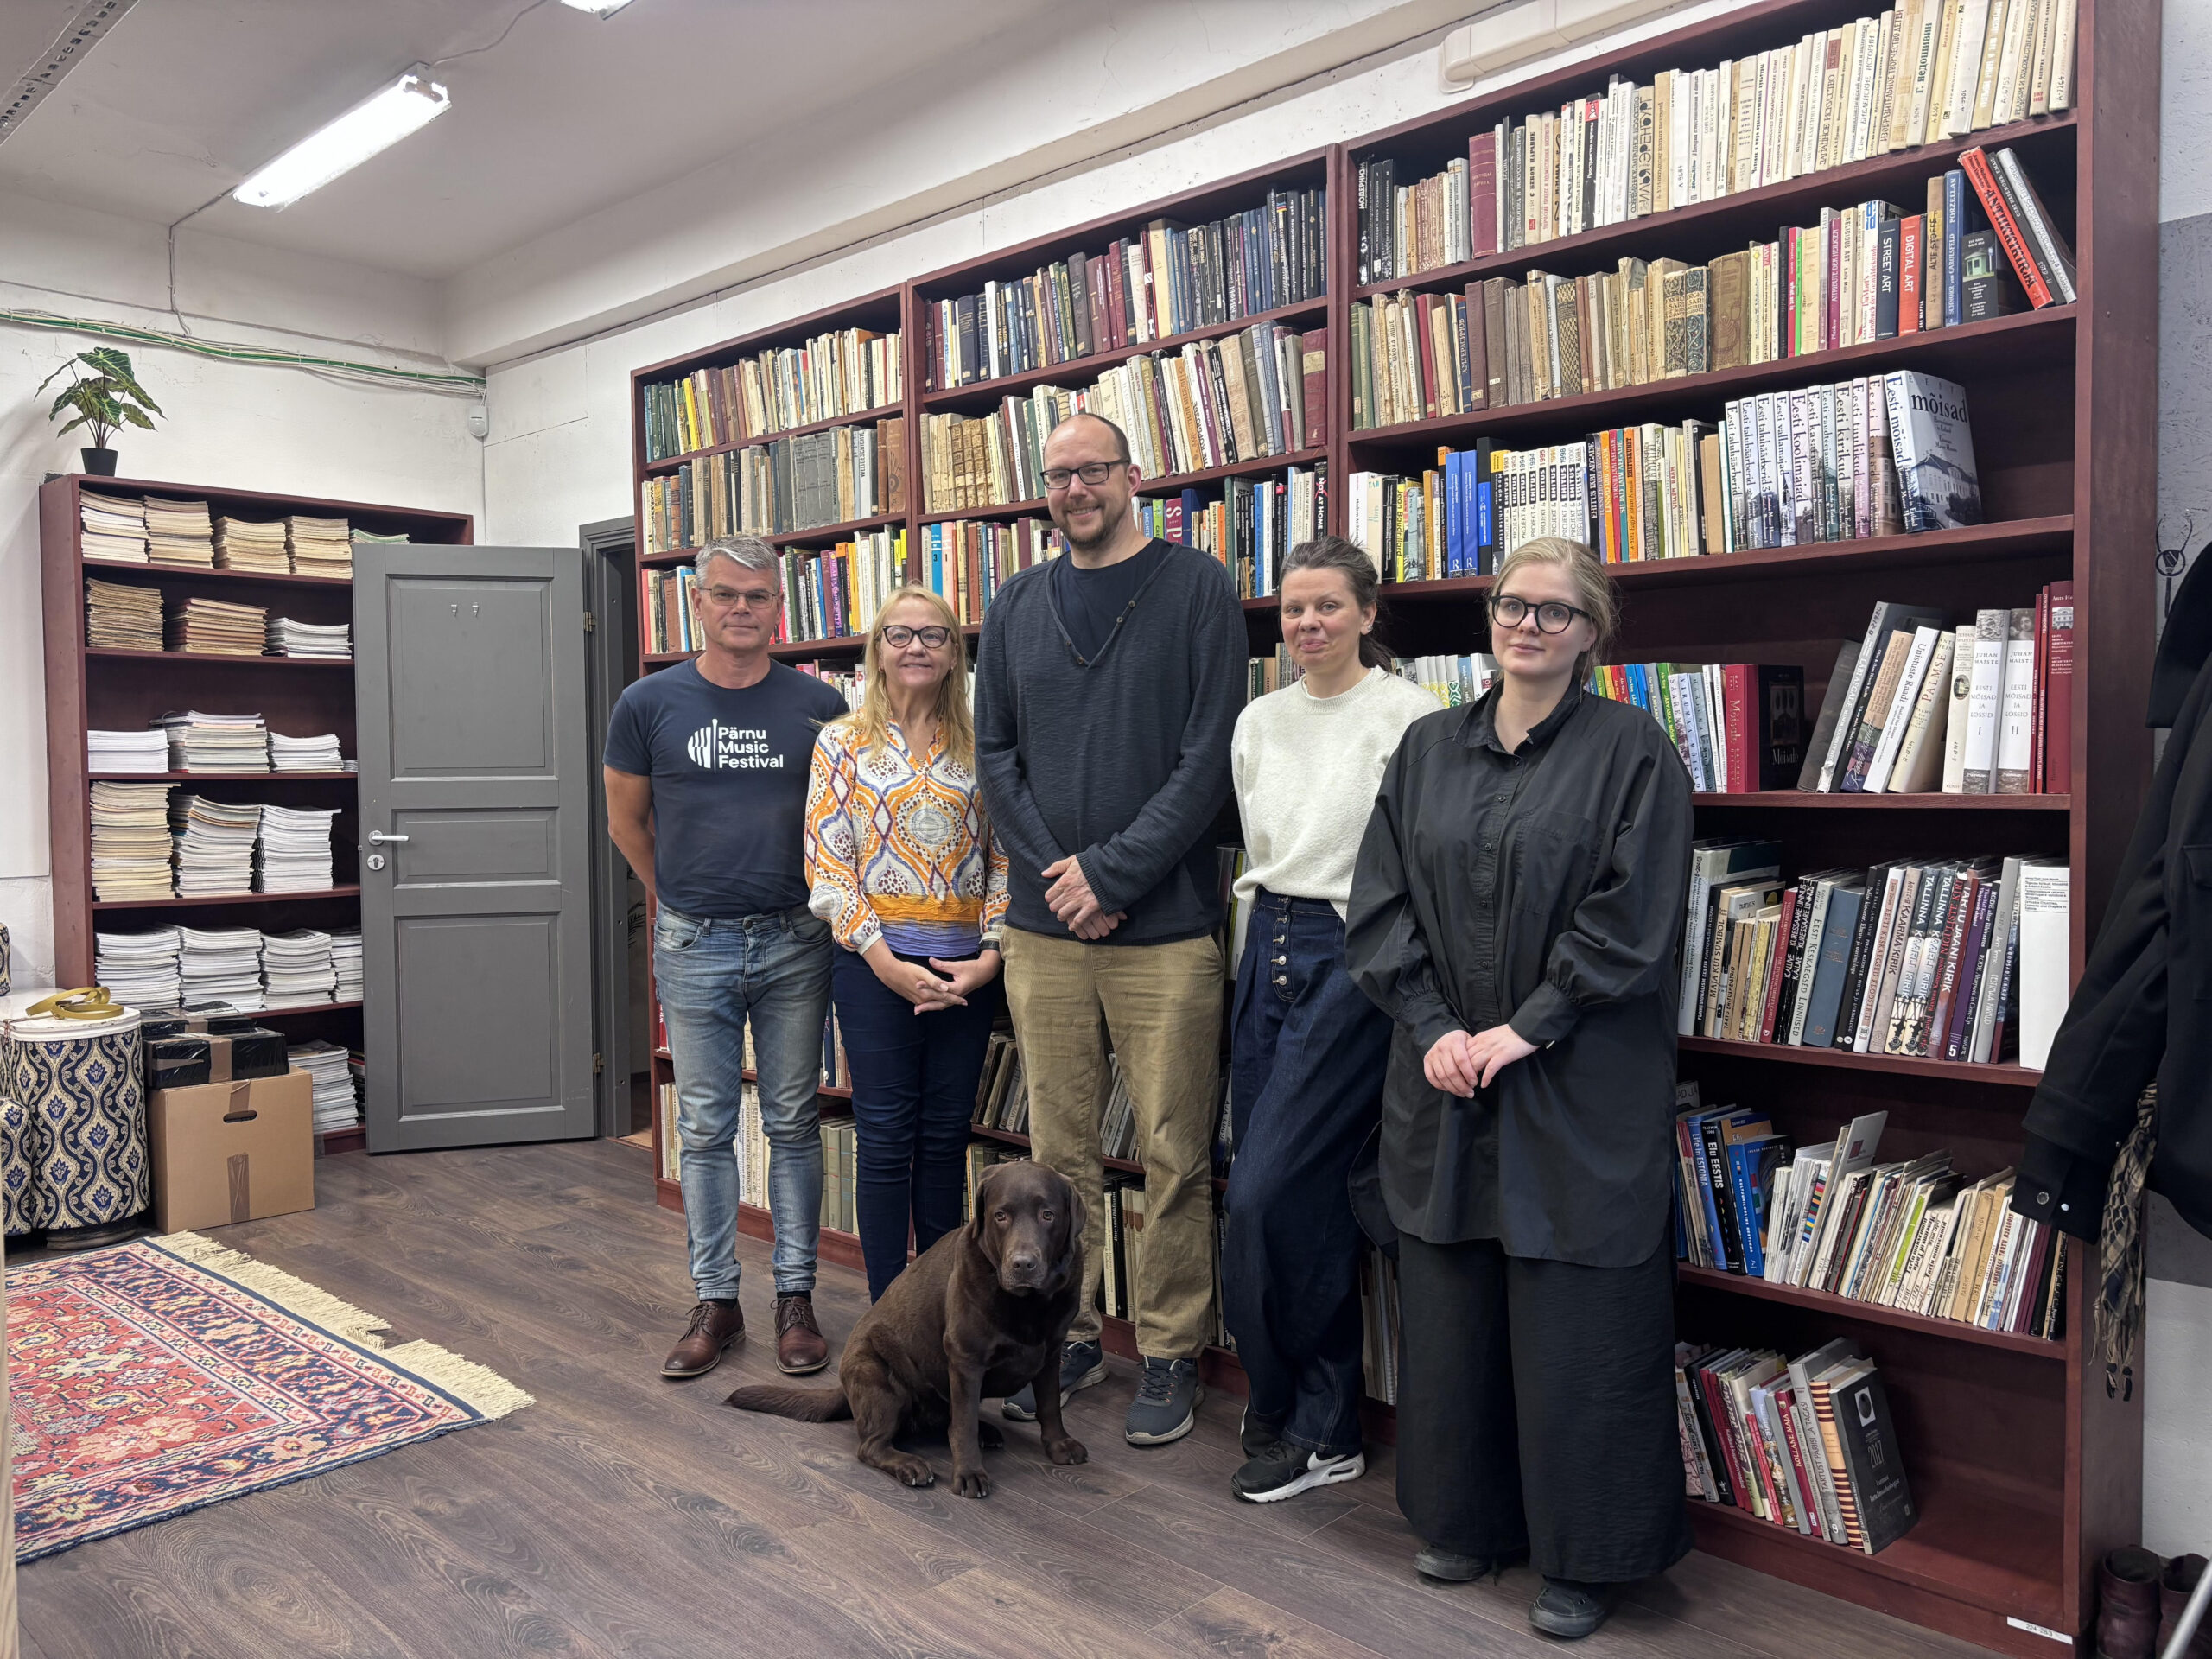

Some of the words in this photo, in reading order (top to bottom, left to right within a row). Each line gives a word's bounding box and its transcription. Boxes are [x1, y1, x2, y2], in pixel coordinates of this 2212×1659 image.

[1866, 35, 1876, 70] ИСТОРИИ
[1824, 74, 1834, 121] ИСКУССТВО
[1880, 74, 1895, 142] ИЗОБРАЗИТЕЛЬНОЕ
[1889, 32, 1901, 73] ТВОРЧЕСТВО
[1637, 96, 1654, 162] ЭРЕНБУРГ
[1820, 124, 1830, 164] ЗАПАДНОЕ
[1637, 168, 1649, 202] ИЛЬЯ
[1929, 215, 1938, 251] STOFFE
[1883, 238, 1892, 273] STREET
[1904, 235, 1915, 272] DIGITAL
[1882, 275, 1891, 292] ART
[1904, 274, 1914, 292] ART
[1758, 397, 1770, 422] Eesti
[1776, 396, 1787, 421] Eesti
[1808, 391, 1820, 421] Eesti
[1837, 385, 1850, 423] Eesti
[1853, 385, 1865, 416] Eesti
[1870, 380, 1880, 418] Eesti
[1886, 376, 1903, 410] Eesti
[1911, 392, 1969, 423] mõisad
[1727, 406, 1738, 430] Eesti
[1791, 395, 1806, 428] Eesti
[1758, 423, 1772, 486] taluhäärberid
[1777, 423, 1789, 475] vallamajad
[1809, 423, 1822, 480] kasarmud
[1838, 427, 1851, 481] kirikud
[1853, 420, 1866, 476] tuulikud
[1870, 428, 1880, 476] linnad
[1891, 415, 1912, 463] mõisad
[1728, 433, 1743, 496] taluhäärberid
[1793, 431, 1808, 503] koolimajad
[1318, 496, 1324, 505] AT
[933, 553, 938, 562] 3
[1906, 643, 1927, 679] Unistuste
[1922, 653, 1947, 702] PALMSE
[1681, 677, 1693, 733] VIRUMAA
[1899, 679, 1915, 702] Raadi
[1970, 692, 1997, 701] MÕISAD
[2005, 691, 2031, 700] MÕISAD
[719, 727, 766, 740] Pärnu
[2011, 725, 2019, 735] II
[719, 741, 769, 753] Music
[719, 754, 784, 768] Festival
[1790, 908, 1802, 946] KURESSAARE
[1798, 884, 1807, 907] LINNUS
[1916, 875, 1935, 925] TALLINNA
[1934, 875, 1952, 925] TALLINNA
[1957, 887, 1971, 923] TARTU
[1797, 910, 1810, 950] KURESSAARE
[1805, 886, 1815, 910] LINNUS
[1812, 918, 1821, 940] EESTI
[1894, 905, 1912, 948] KAARMA
[1940, 902, 1958, 955] NIGULISTE
[1953, 880, 1965, 902] KIRI
[1907, 930, 1923, 969] KAARLI
[1924, 930, 1941, 969] KAARLI
[1949, 925, 1963, 959] JAANI
[1801, 944, 1818, 993] KESKAEGSED
[1889, 949, 1901, 976] KIRIK
[1942, 961, 1957, 994] KIRIK
[1710, 976, 1720, 998] MAJA
[1902, 971, 1915, 1000] KIRIK
[1919, 972, 1932, 1001] KIRIK
[1793, 996, 1808, 1037] LINNUSED
[1949, 1044, 1957, 1056] 5
[1692, 1133, 1700, 1147] Life
[1697, 1154, 1708, 1187] ESTONIA
[1707, 1141, 1717, 1156] Elu
[1711, 1159, 1725, 1189] EESTIS
[1998, 1238, 2007, 1256] TARTU
[1904, 1255, 1914, 1273] Tartu
[1924, 1259, 1935, 1278] Tartu
[1783, 1413, 1793, 1433] MAJA
[1802, 1401, 1815, 1427] TAGASI
[1808, 1427, 1817, 1436] JA
[1809, 1436, 1822, 1460] PARIISI
[1787, 1434, 1802, 1467] KOLLANE
[1867, 1440, 1885, 1468] 2017
[1815, 1460, 1827, 1492] TARTUST
